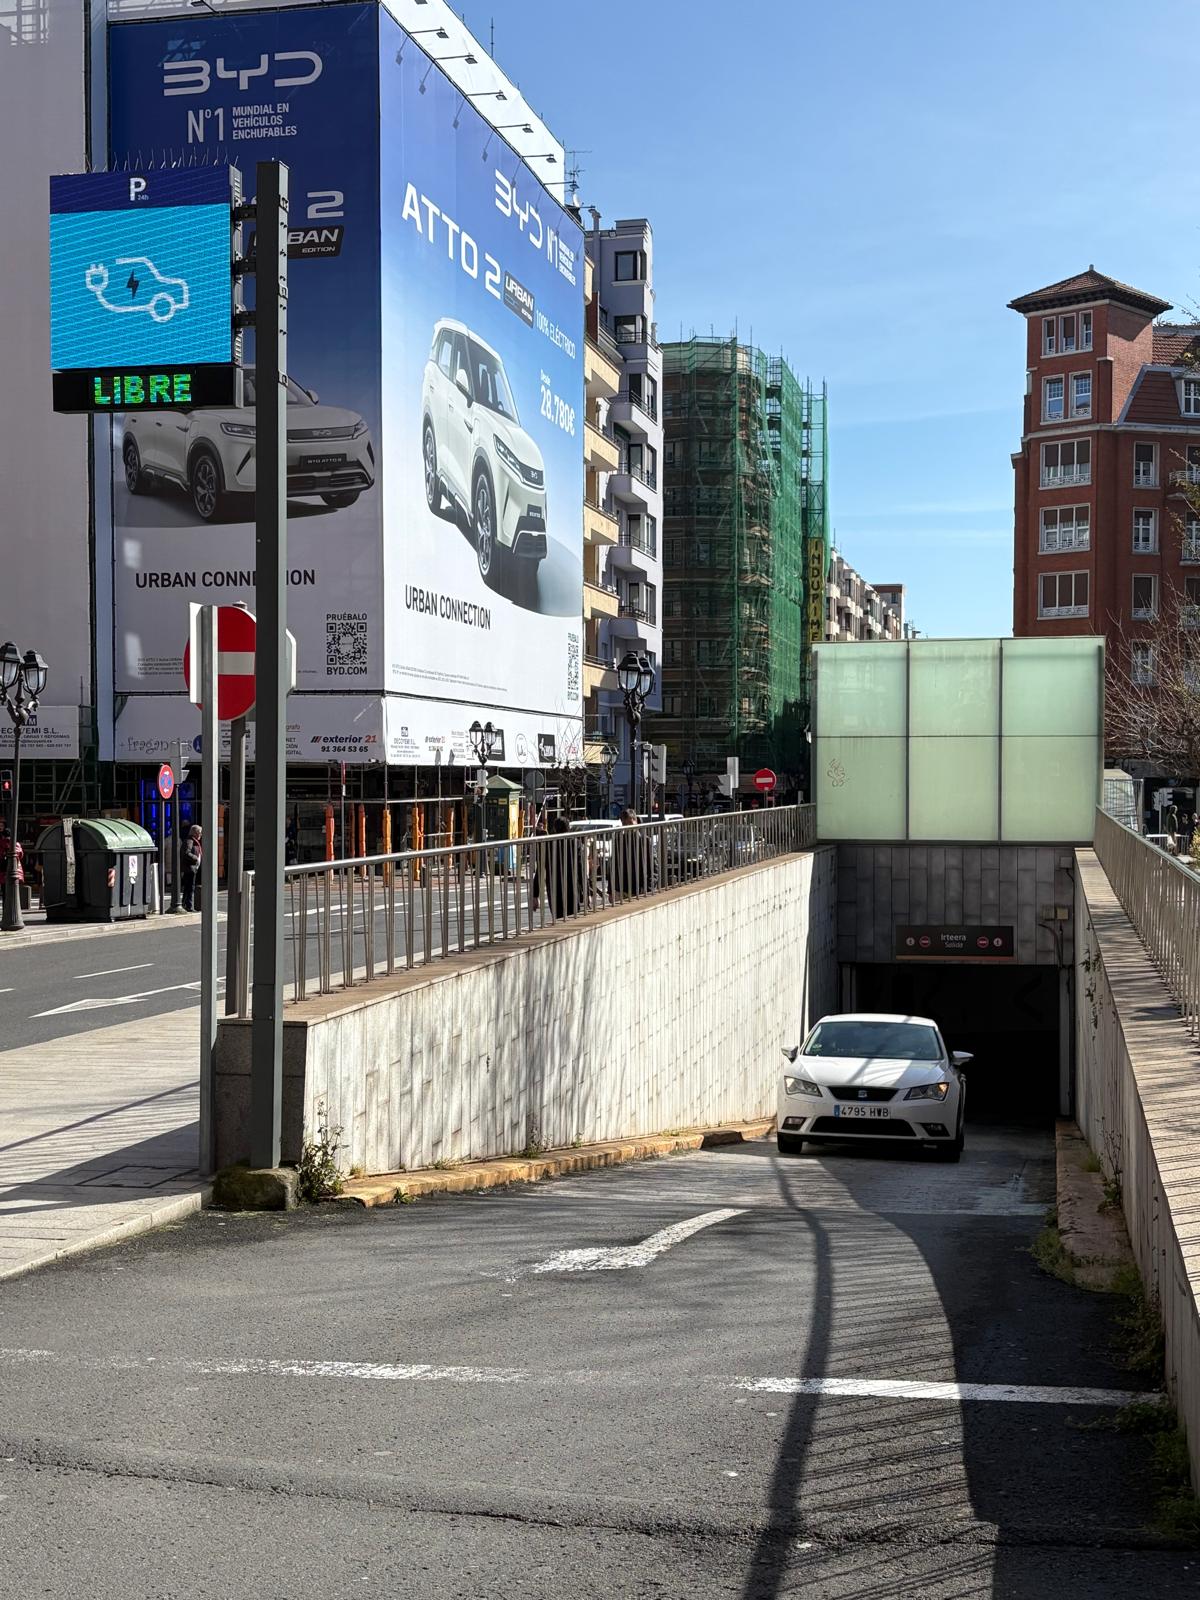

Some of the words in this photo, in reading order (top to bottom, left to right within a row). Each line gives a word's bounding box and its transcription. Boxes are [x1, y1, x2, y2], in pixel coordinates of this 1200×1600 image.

[164, 50, 323, 96] BYD
[232, 104, 274, 116] MUNDIAL
[277, 103, 290, 113] EN
[232, 115, 283, 128] VEHÍCULOS
[232, 126, 298, 140] ENCHUFABLES
[130, 178, 146, 201] P
[307, 190, 344, 219] 2
[495, 169, 543, 249] BYD
[302, 246, 336, 254] EDITION
[401, 182, 478, 280] ATTO
[485, 252, 501, 300] 2
[505, 276, 534, 311] URBAN
[536, 310, 549, 337] 100%
[549, 322, 576, 360] ELÉCTRICO
[94, 374, 192, 405] LIBRE
[540, 384, 576, 438] 28.780€
[136, 572, 196, 588] URBAN
[326, 612, 368, 621] PRUÉBALO
[405, 584, 438, 617] URBAN
[440, 595, 491, 630] CONNECTION
[326, 667, 368, 675] BYD.COM
[322, 734, 363, 743] exterior
[364, 734, 377, 743] 21
[841, 1107, 866, 1116] 4795
[870, 1108, 889, 1117] HWB
